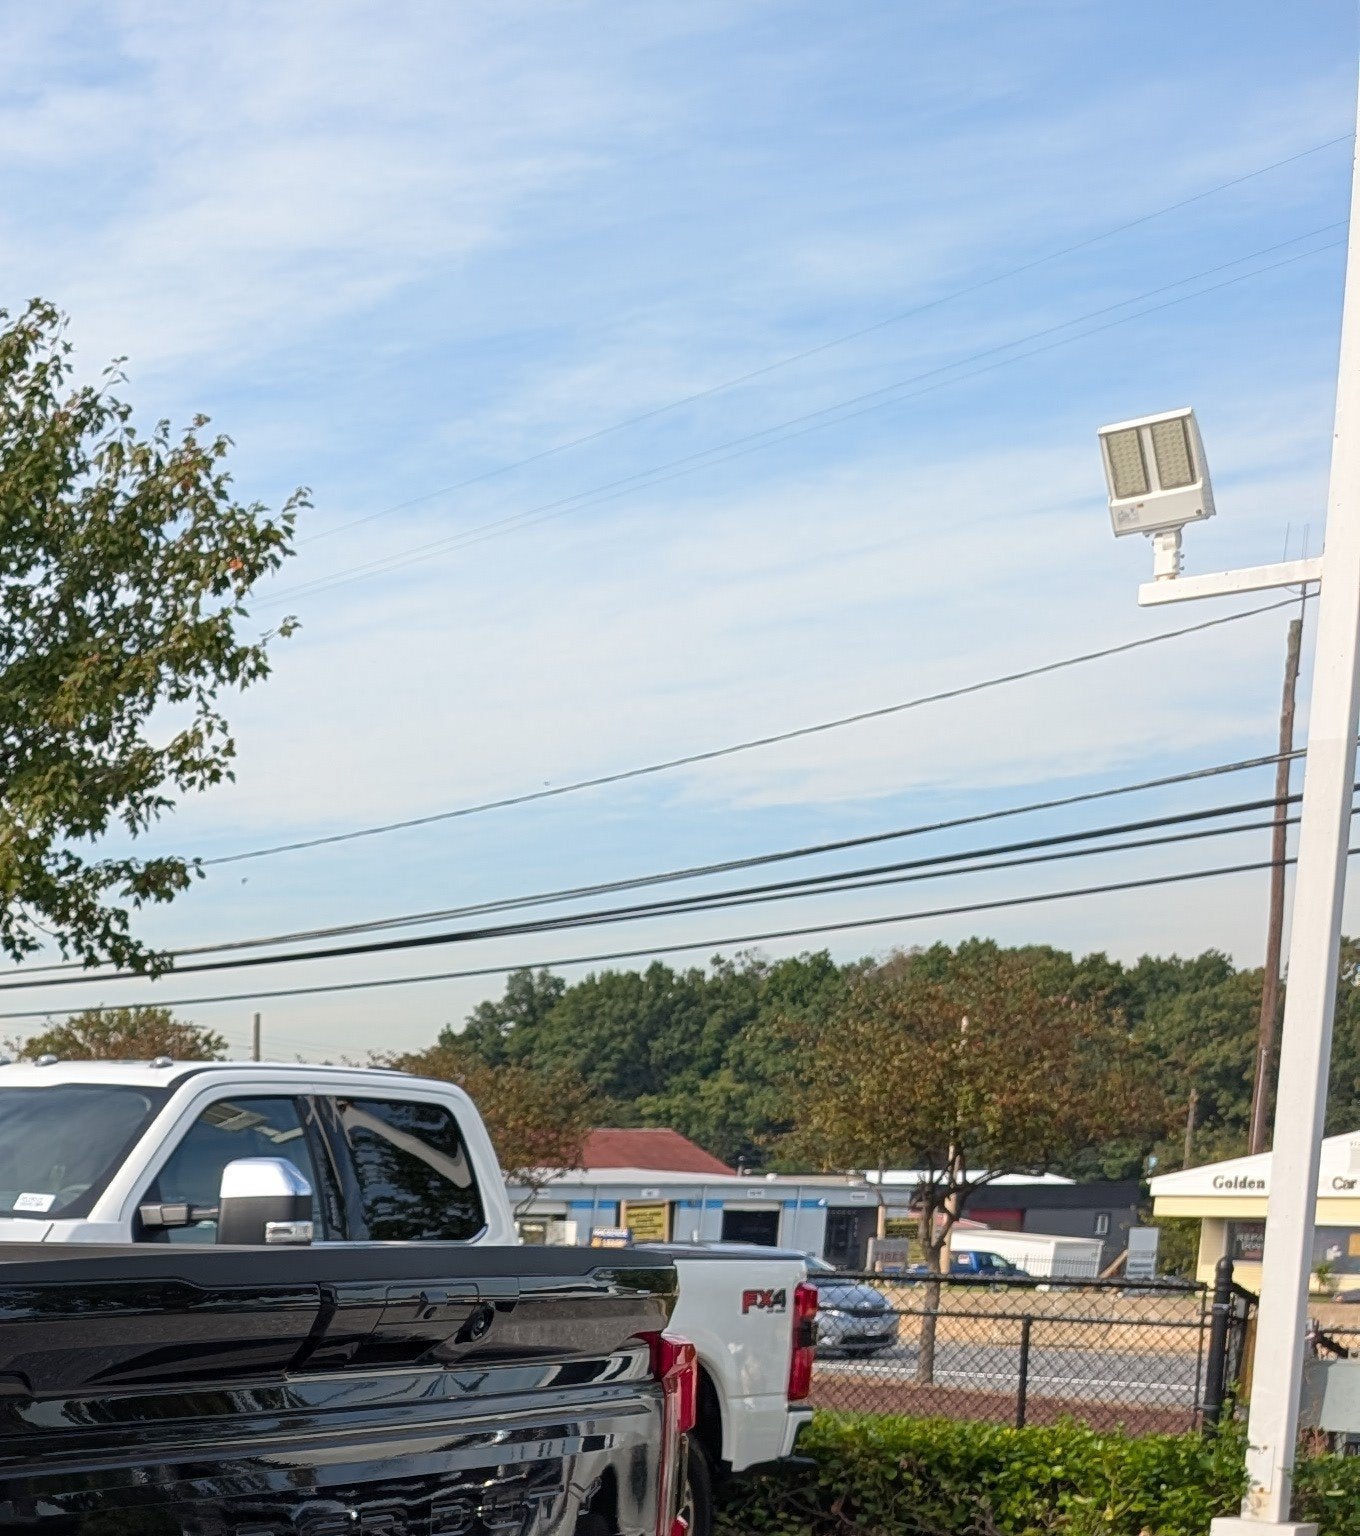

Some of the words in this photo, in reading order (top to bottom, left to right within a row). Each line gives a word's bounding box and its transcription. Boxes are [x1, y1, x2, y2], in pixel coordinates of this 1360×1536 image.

[1213, 1175, 1266, 1190] Golden
[1332, 1176, 1358, 1190] Car
[741, 1289, 787, 1315] FX4
